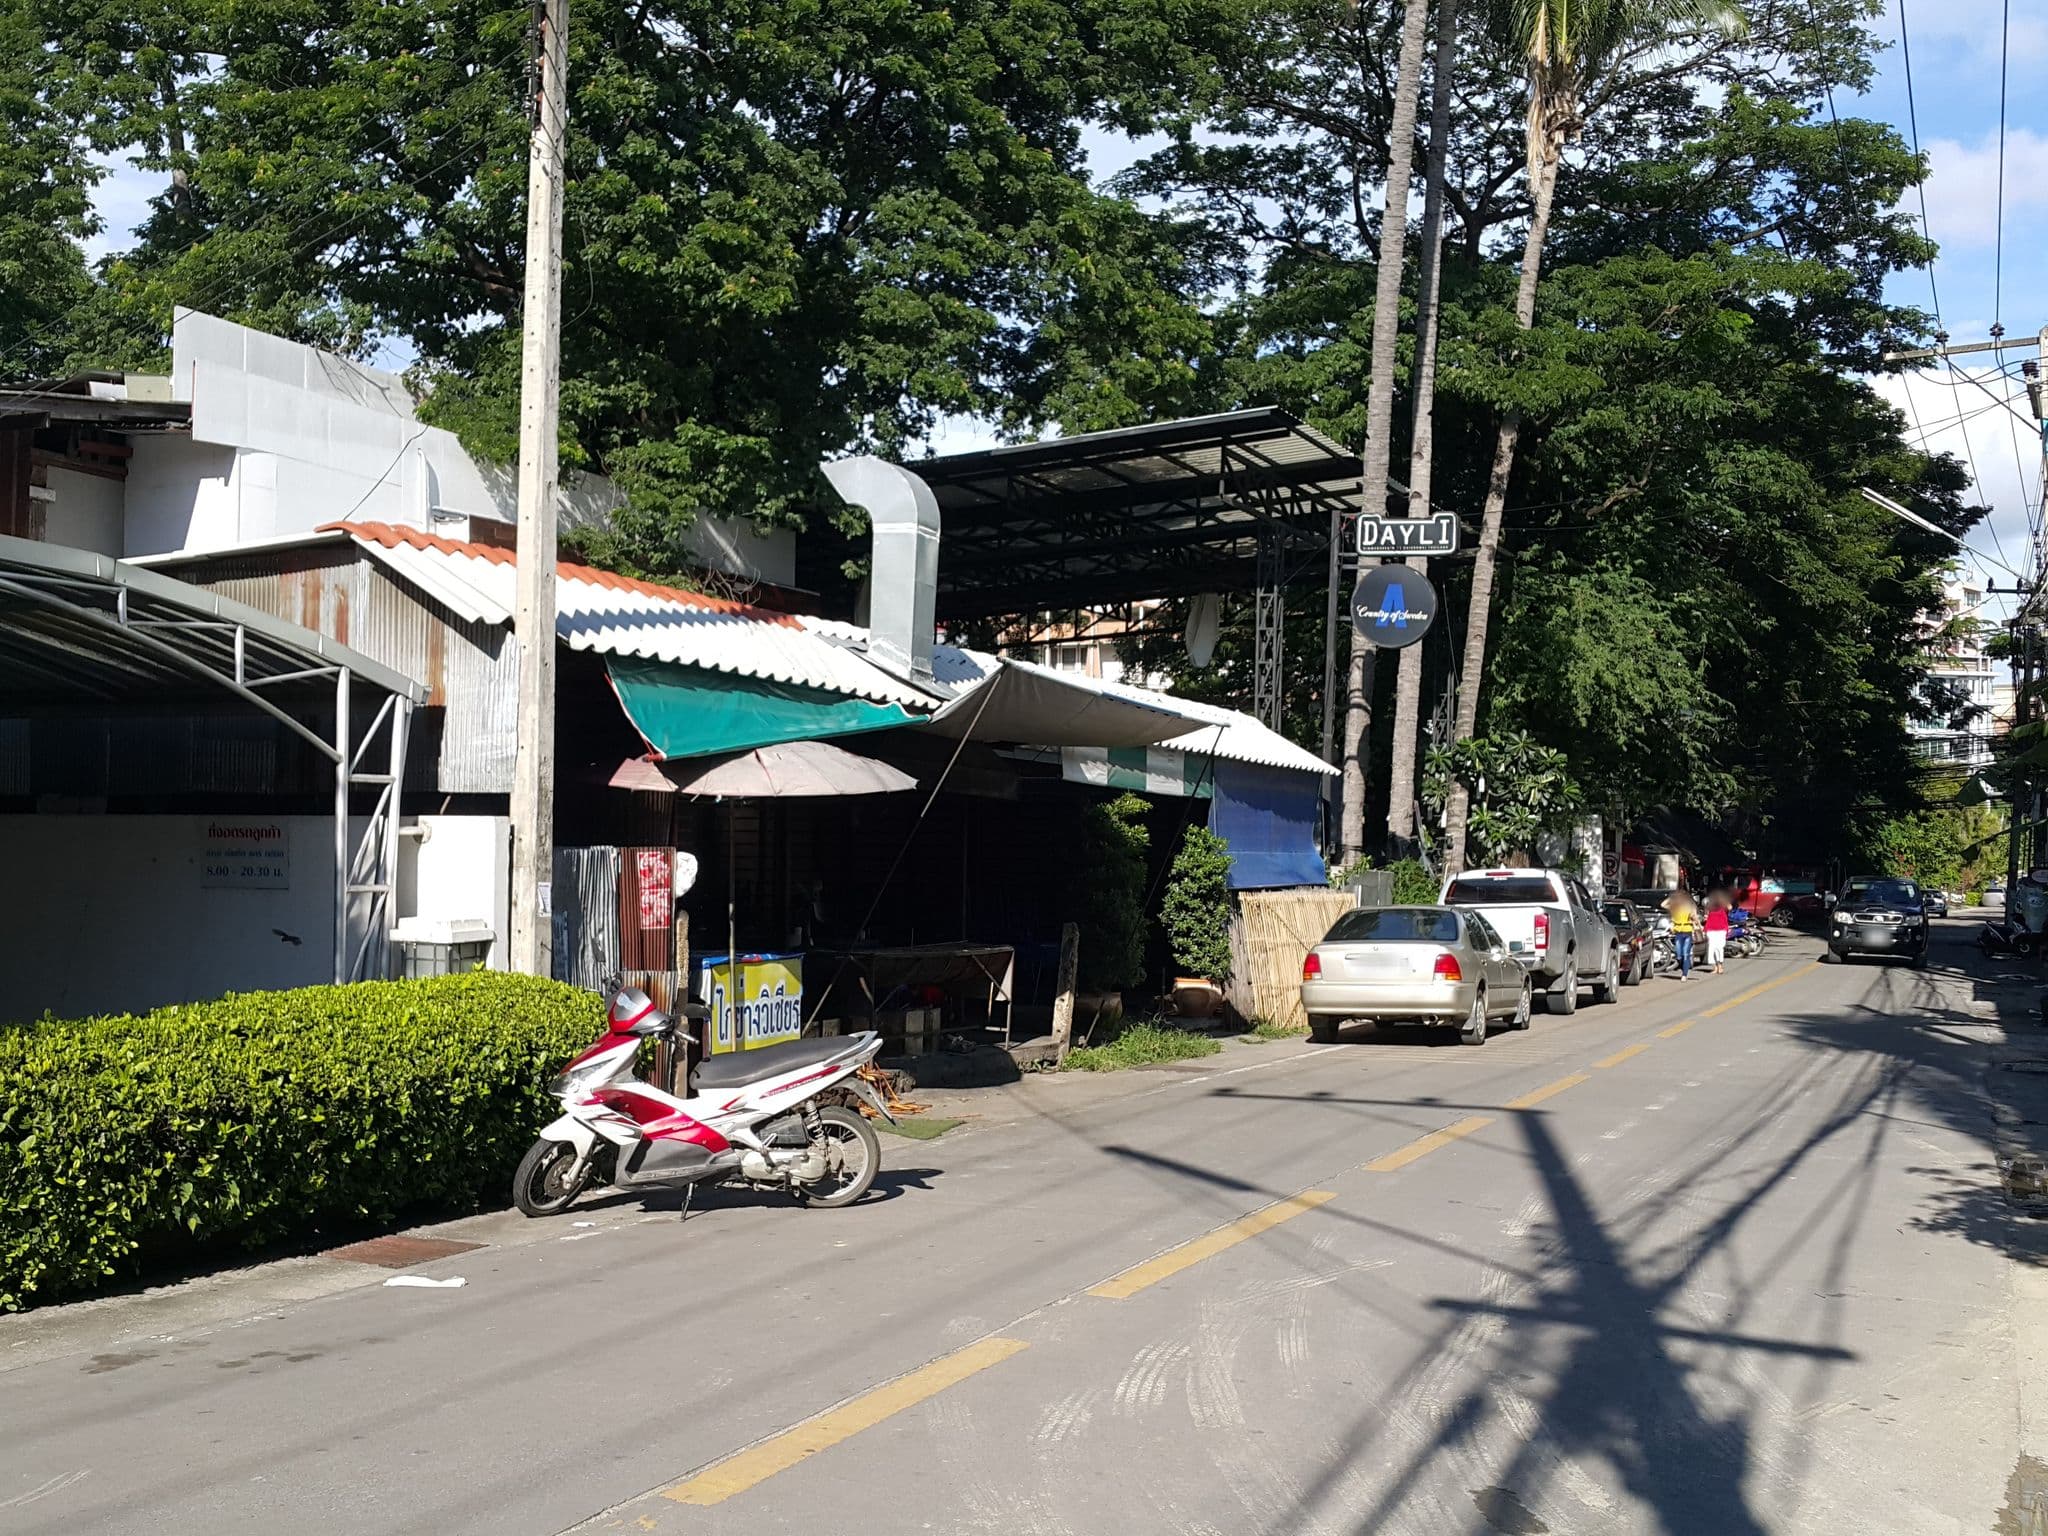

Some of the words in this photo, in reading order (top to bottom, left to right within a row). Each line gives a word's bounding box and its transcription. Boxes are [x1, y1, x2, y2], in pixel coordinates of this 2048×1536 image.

[1362, 519, 1450, 546] DAYLI
[1375, 583, 1408, 629] A
[207, 866, 229, 877] 8.00
[240, 866, 270, 877] 20.30
[714, 977, 800, 1041] ไกย่างวิเชียร
